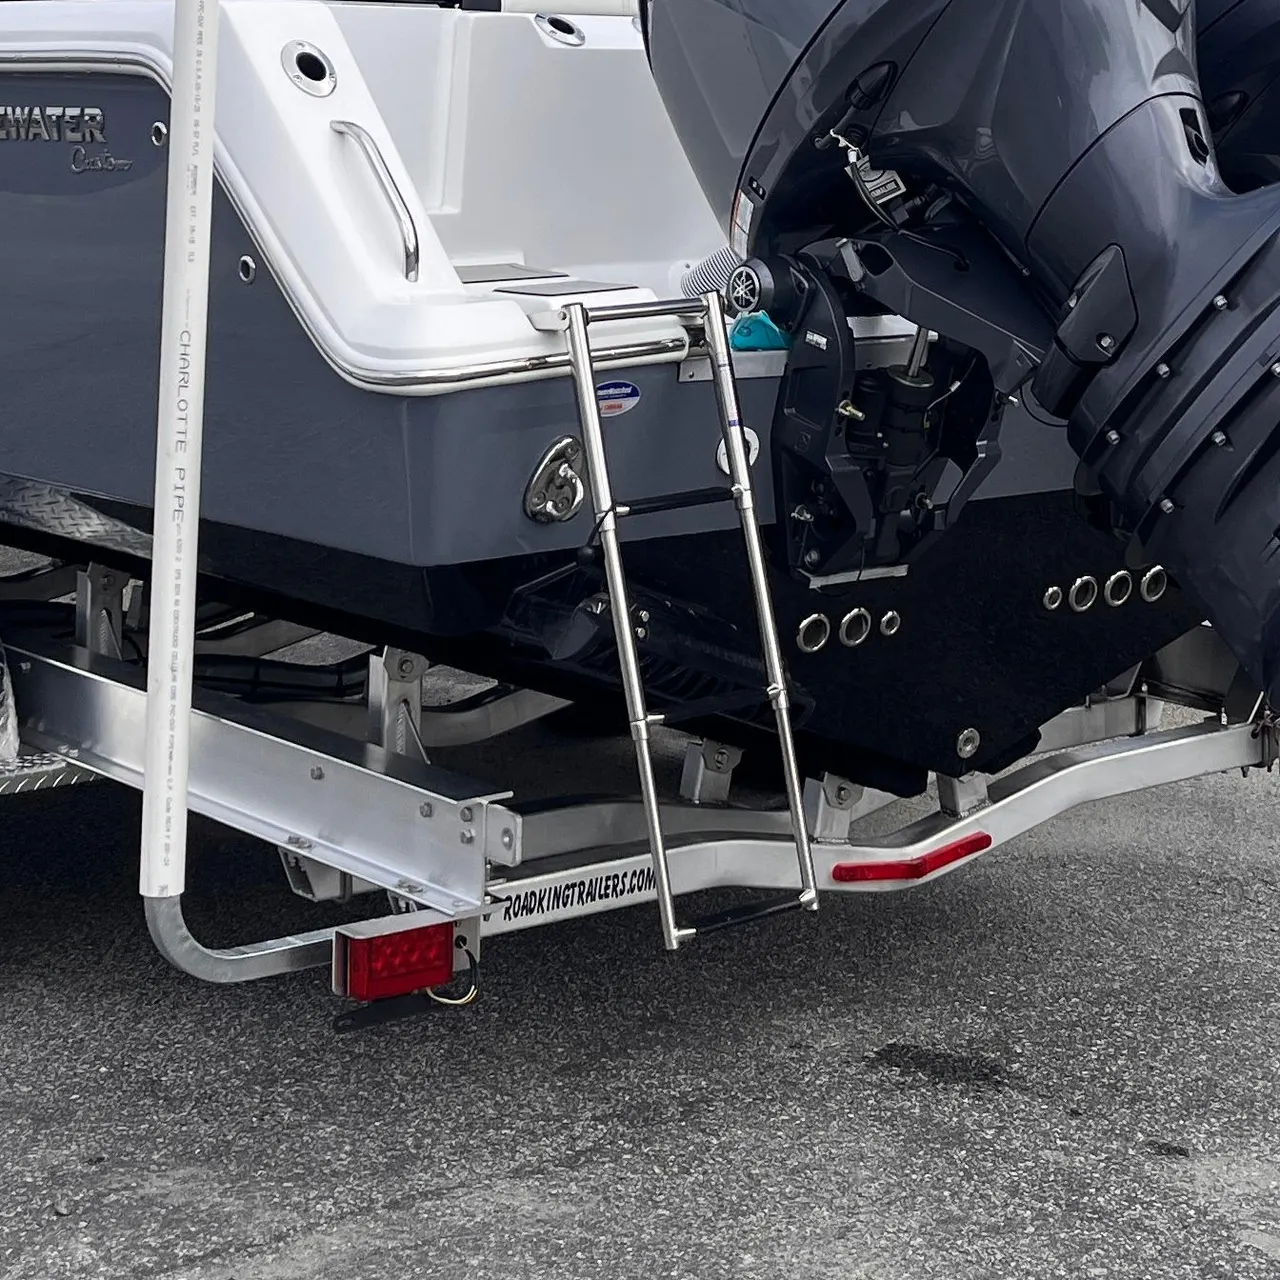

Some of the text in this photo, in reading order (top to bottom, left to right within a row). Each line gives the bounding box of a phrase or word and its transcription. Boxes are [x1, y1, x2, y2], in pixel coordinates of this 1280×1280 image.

[174, 329, 192, 454] CHARLOTTE
[172, 467, 187, 525] PIPE
[503, 866, 657, 921] ROADKINGTRAILERS.COM
